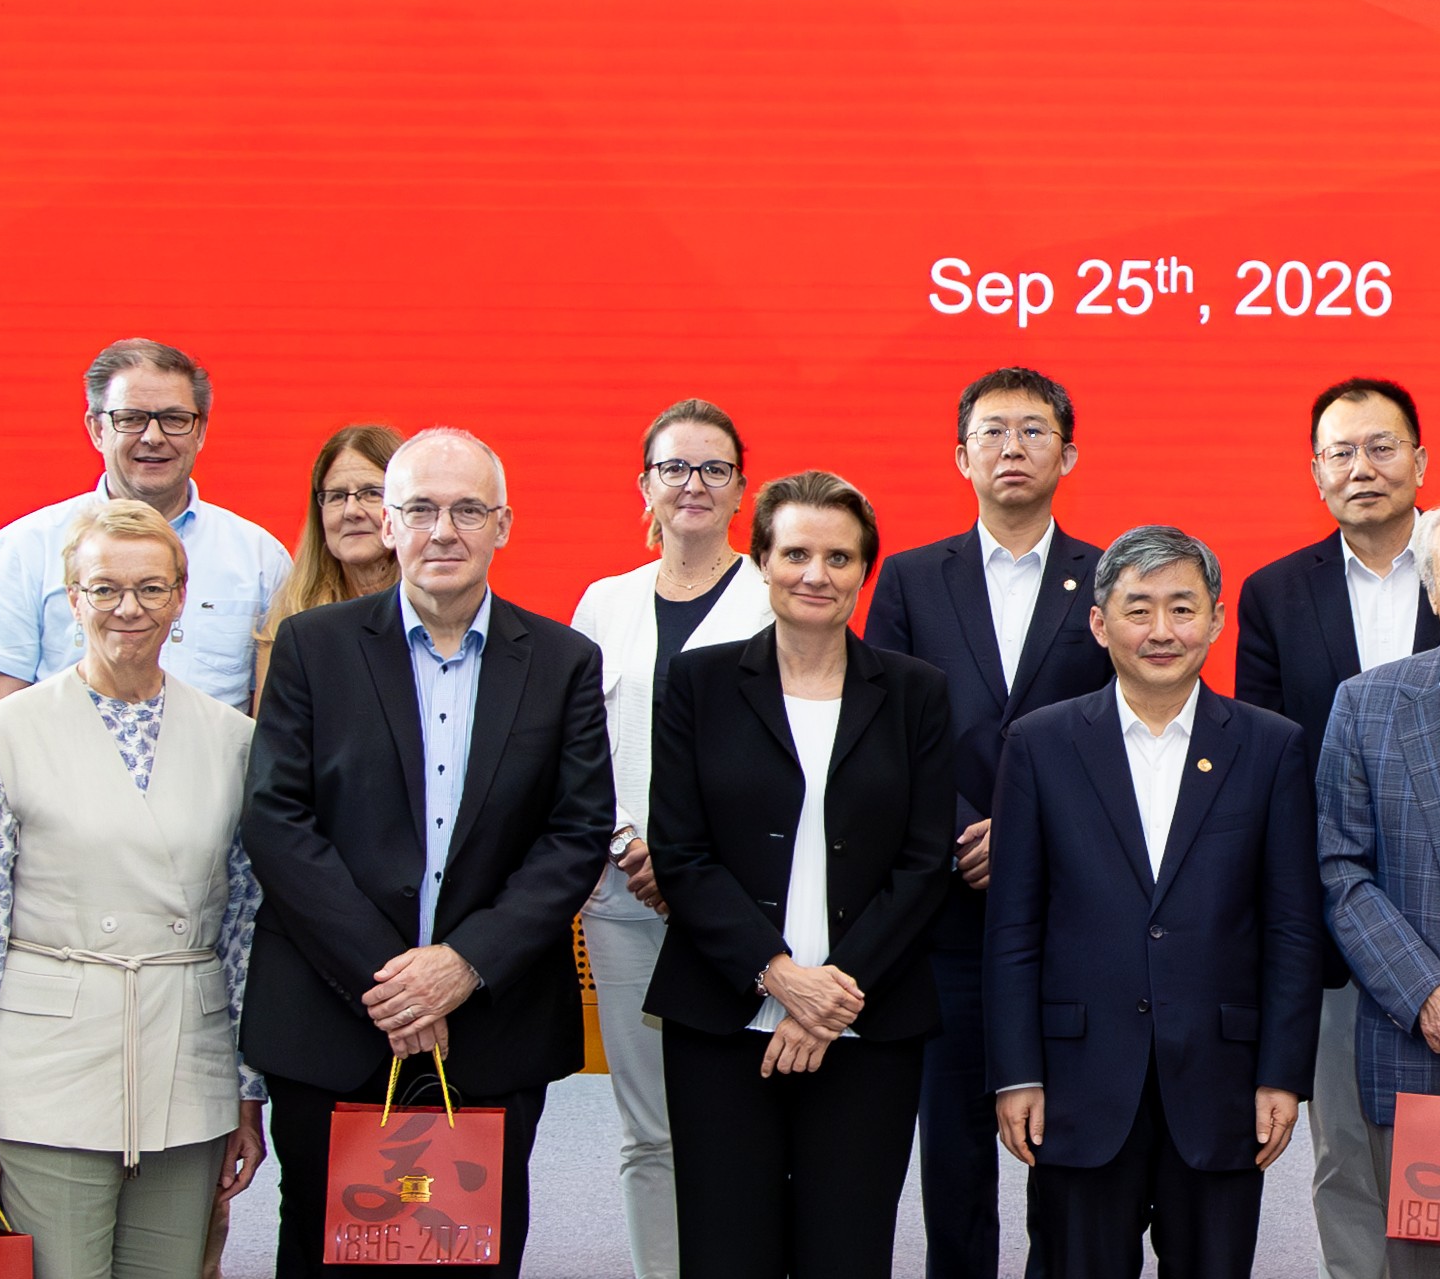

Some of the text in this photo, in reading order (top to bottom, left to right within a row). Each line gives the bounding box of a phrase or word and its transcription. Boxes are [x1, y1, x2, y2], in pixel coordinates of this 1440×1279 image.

[929, 255, 1393, 328] Sep 25th, 2026
